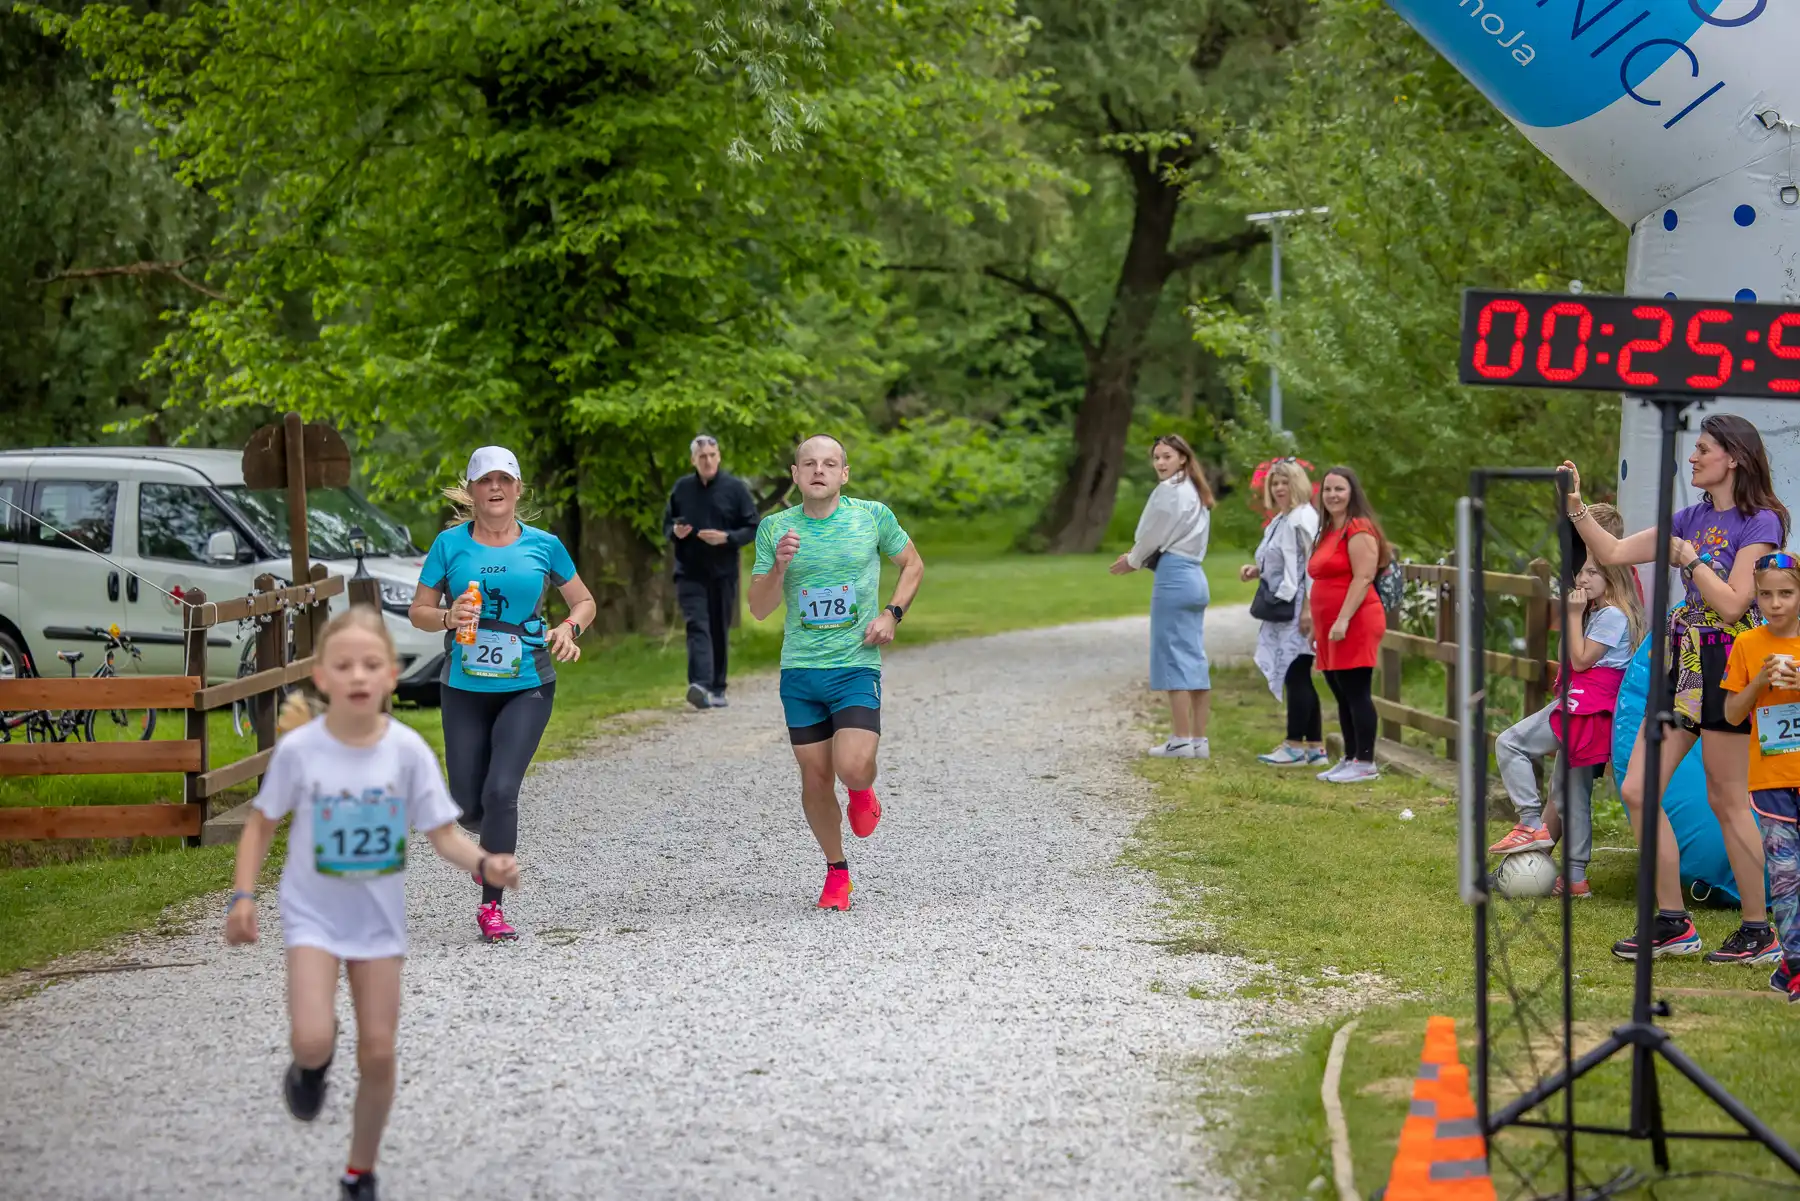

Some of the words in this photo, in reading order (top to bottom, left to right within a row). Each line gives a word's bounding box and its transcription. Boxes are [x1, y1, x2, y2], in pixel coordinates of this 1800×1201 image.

[481, 566, 507, 574] 2024
[809, 598, 847, 617] 178
[476, 645, 503, 665] 26
[1777, 717, 1800, 740] 25
[330, 825, 391, 856] 123
